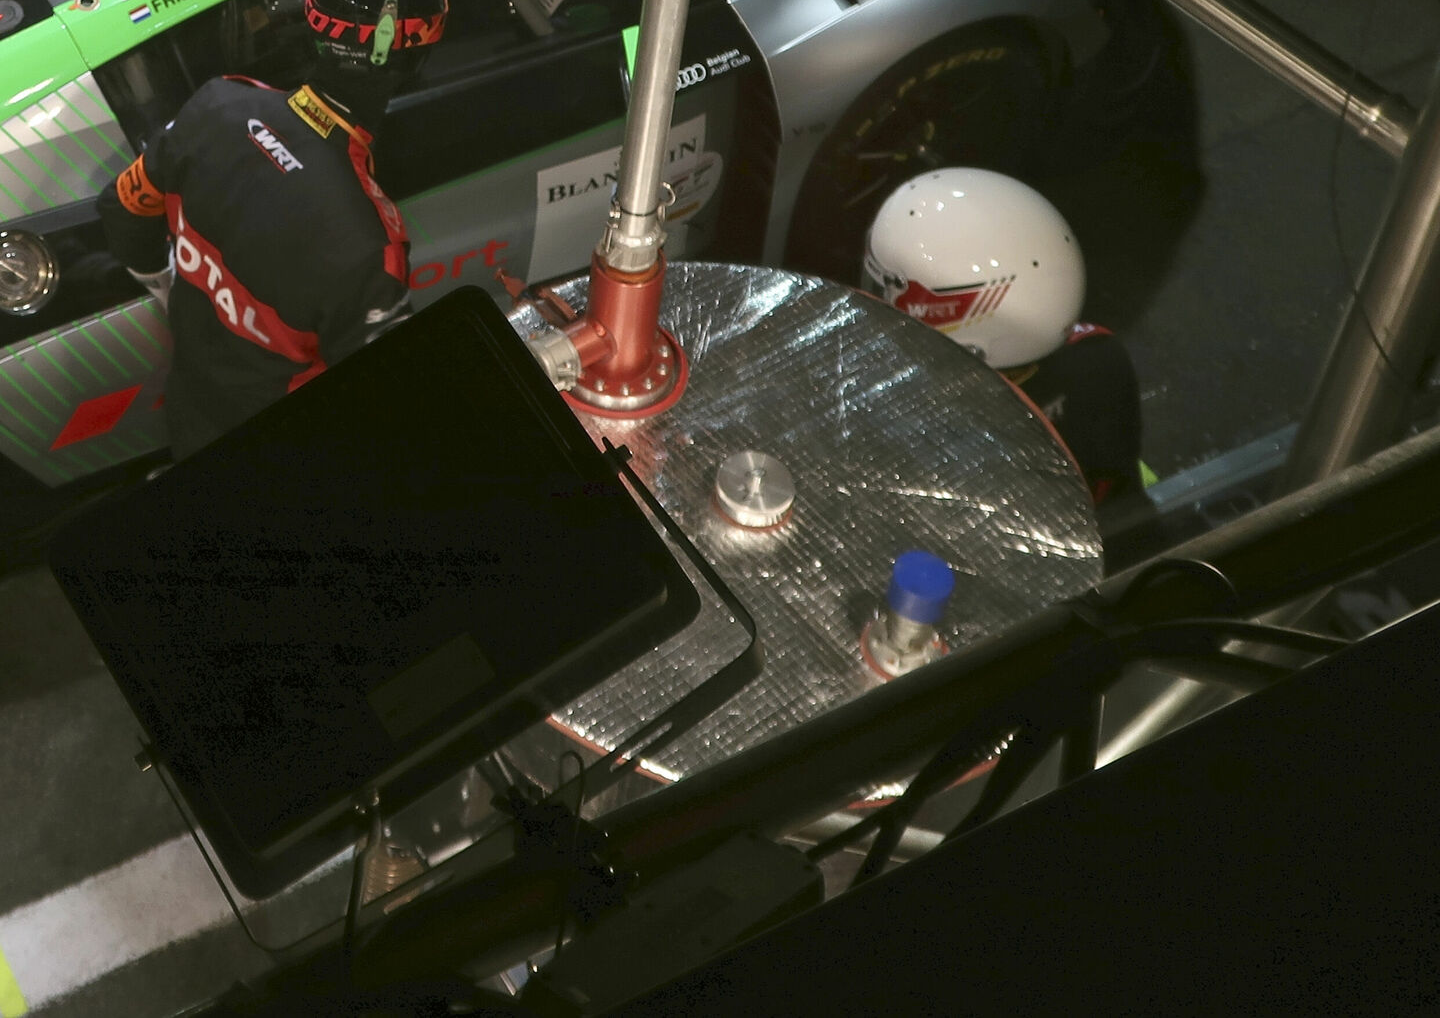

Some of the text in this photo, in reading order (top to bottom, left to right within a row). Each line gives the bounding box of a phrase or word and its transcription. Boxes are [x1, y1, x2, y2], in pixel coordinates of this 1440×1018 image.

[706, 49, 740, 67] Belgian
[254, 129, 304, 172] WRT
[409, 239, 510, 290] ort
[907, 300, 962, 320] WRT
